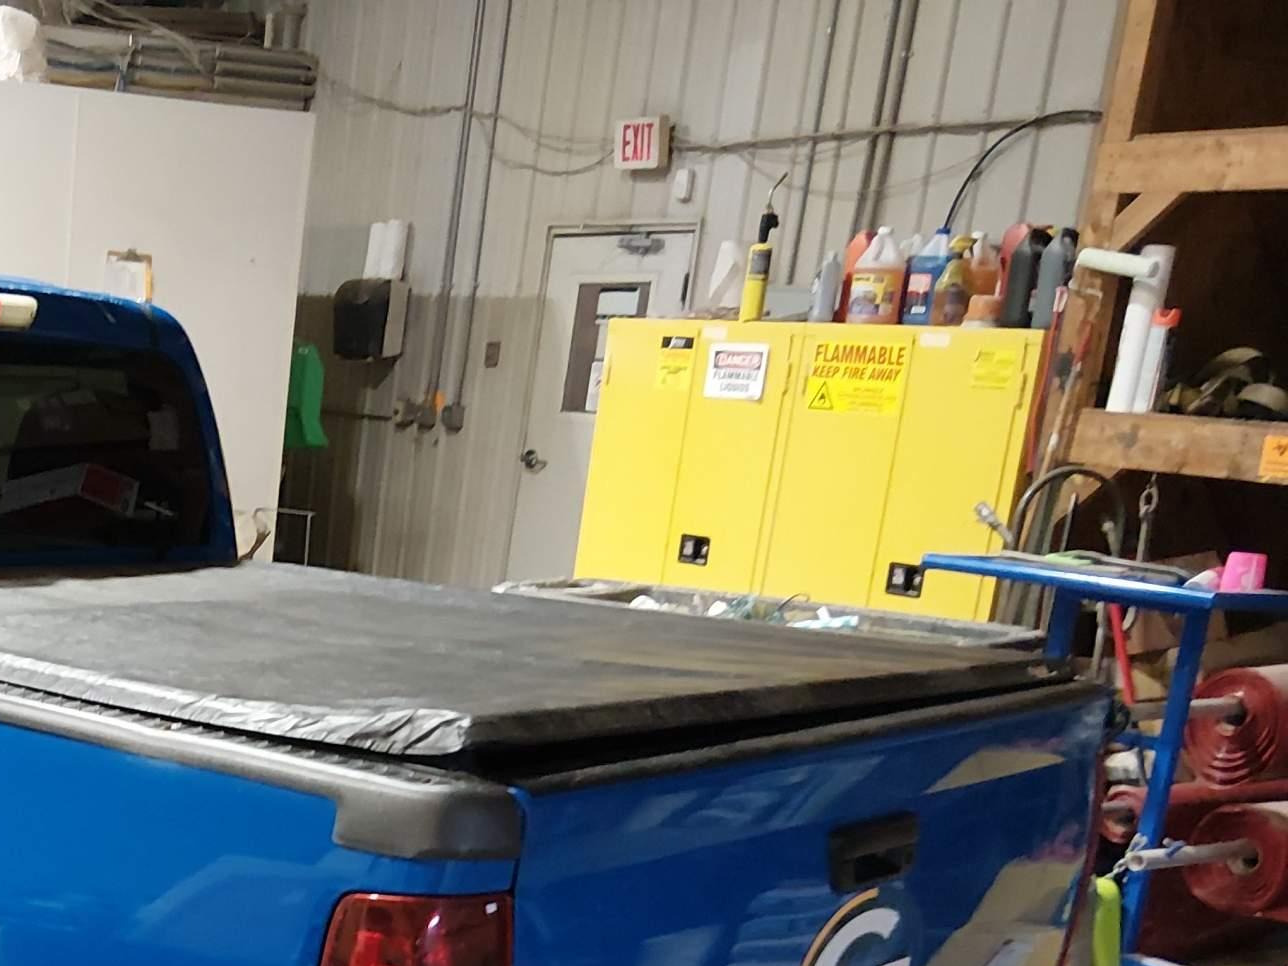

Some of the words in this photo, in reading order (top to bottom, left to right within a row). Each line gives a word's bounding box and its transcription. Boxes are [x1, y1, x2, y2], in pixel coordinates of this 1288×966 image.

[622, 122, 654, 161] EXIT
[715, 352, 761, 368] DANGER
[814, 343, 906, 366] FLAMMABLE
[713, 369, 759, 381] FLAMMABLE
[812, 364, 840, 378] KEEP
[841, 366, 868, 380] FIRE
[868, 367, 902, 383] AWAY
